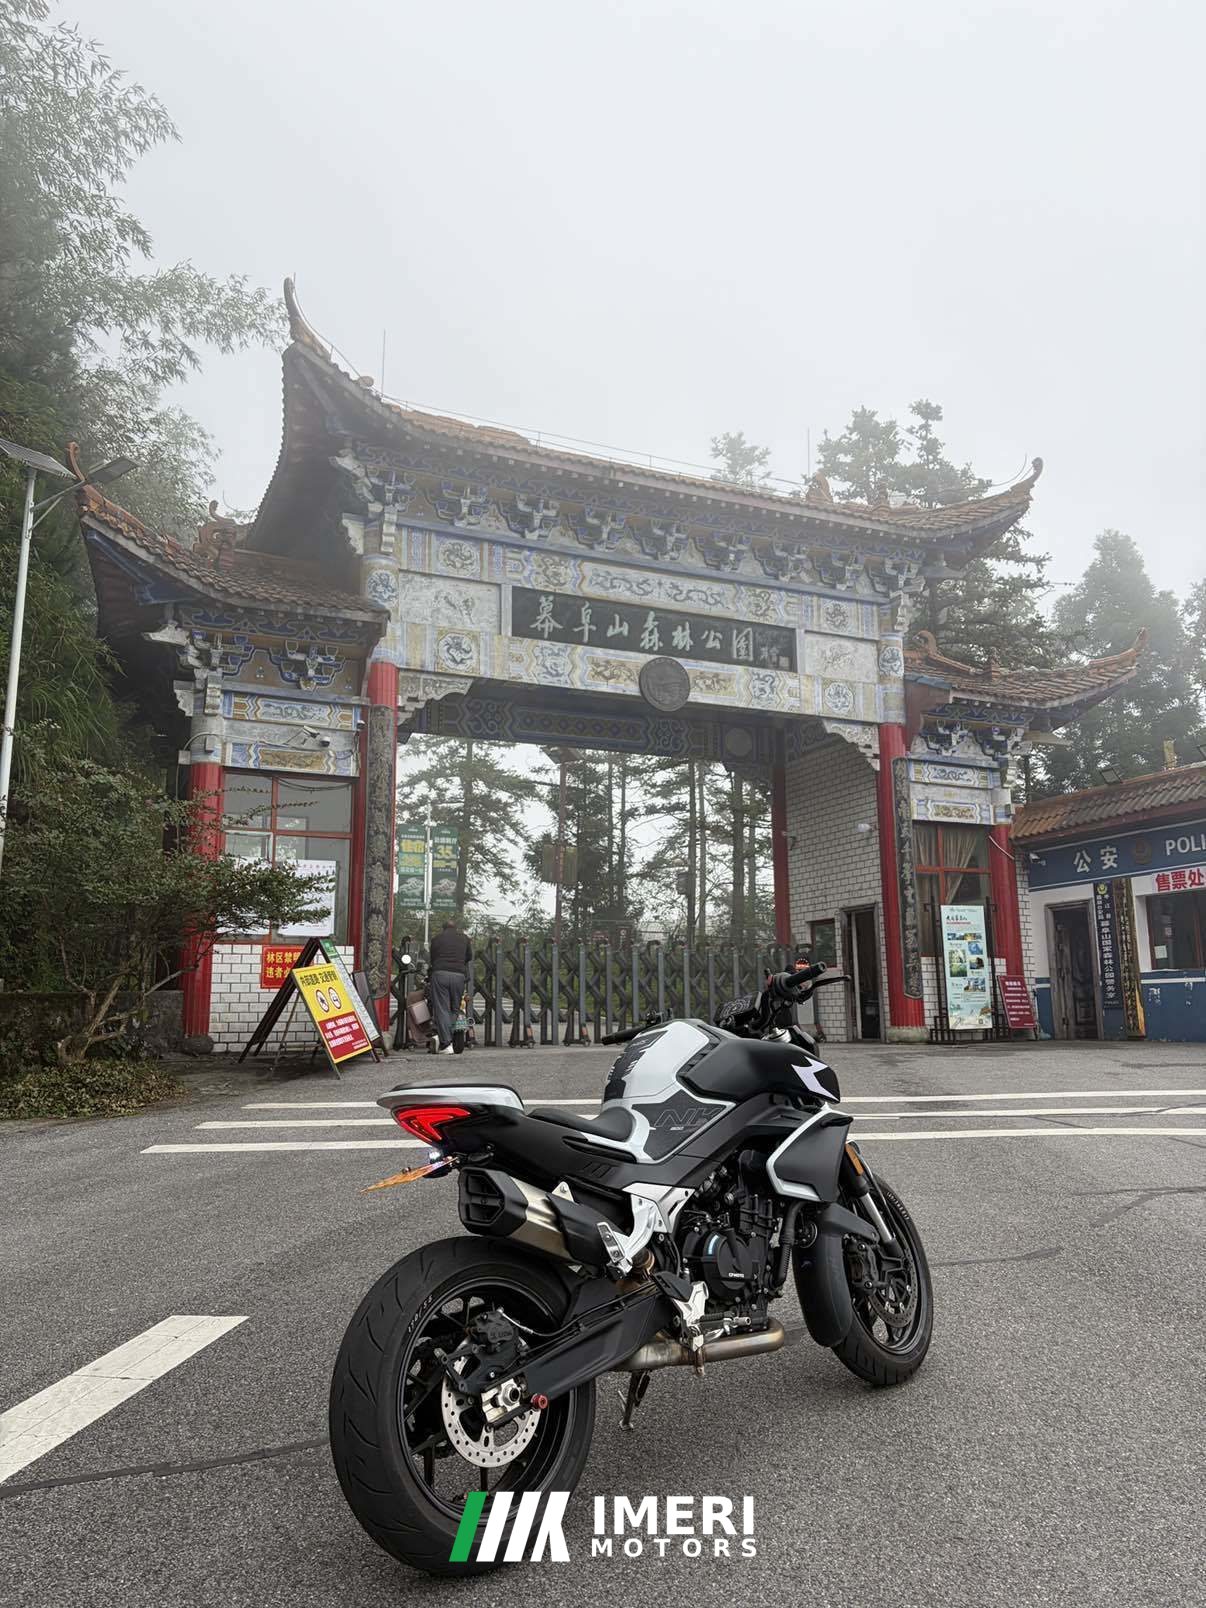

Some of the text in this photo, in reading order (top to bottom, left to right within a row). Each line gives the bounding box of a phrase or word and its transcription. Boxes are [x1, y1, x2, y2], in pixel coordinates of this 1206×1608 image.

[1073, 845, 1118, 873] 公安
[1156, 867, 1205, 892] 售票处
